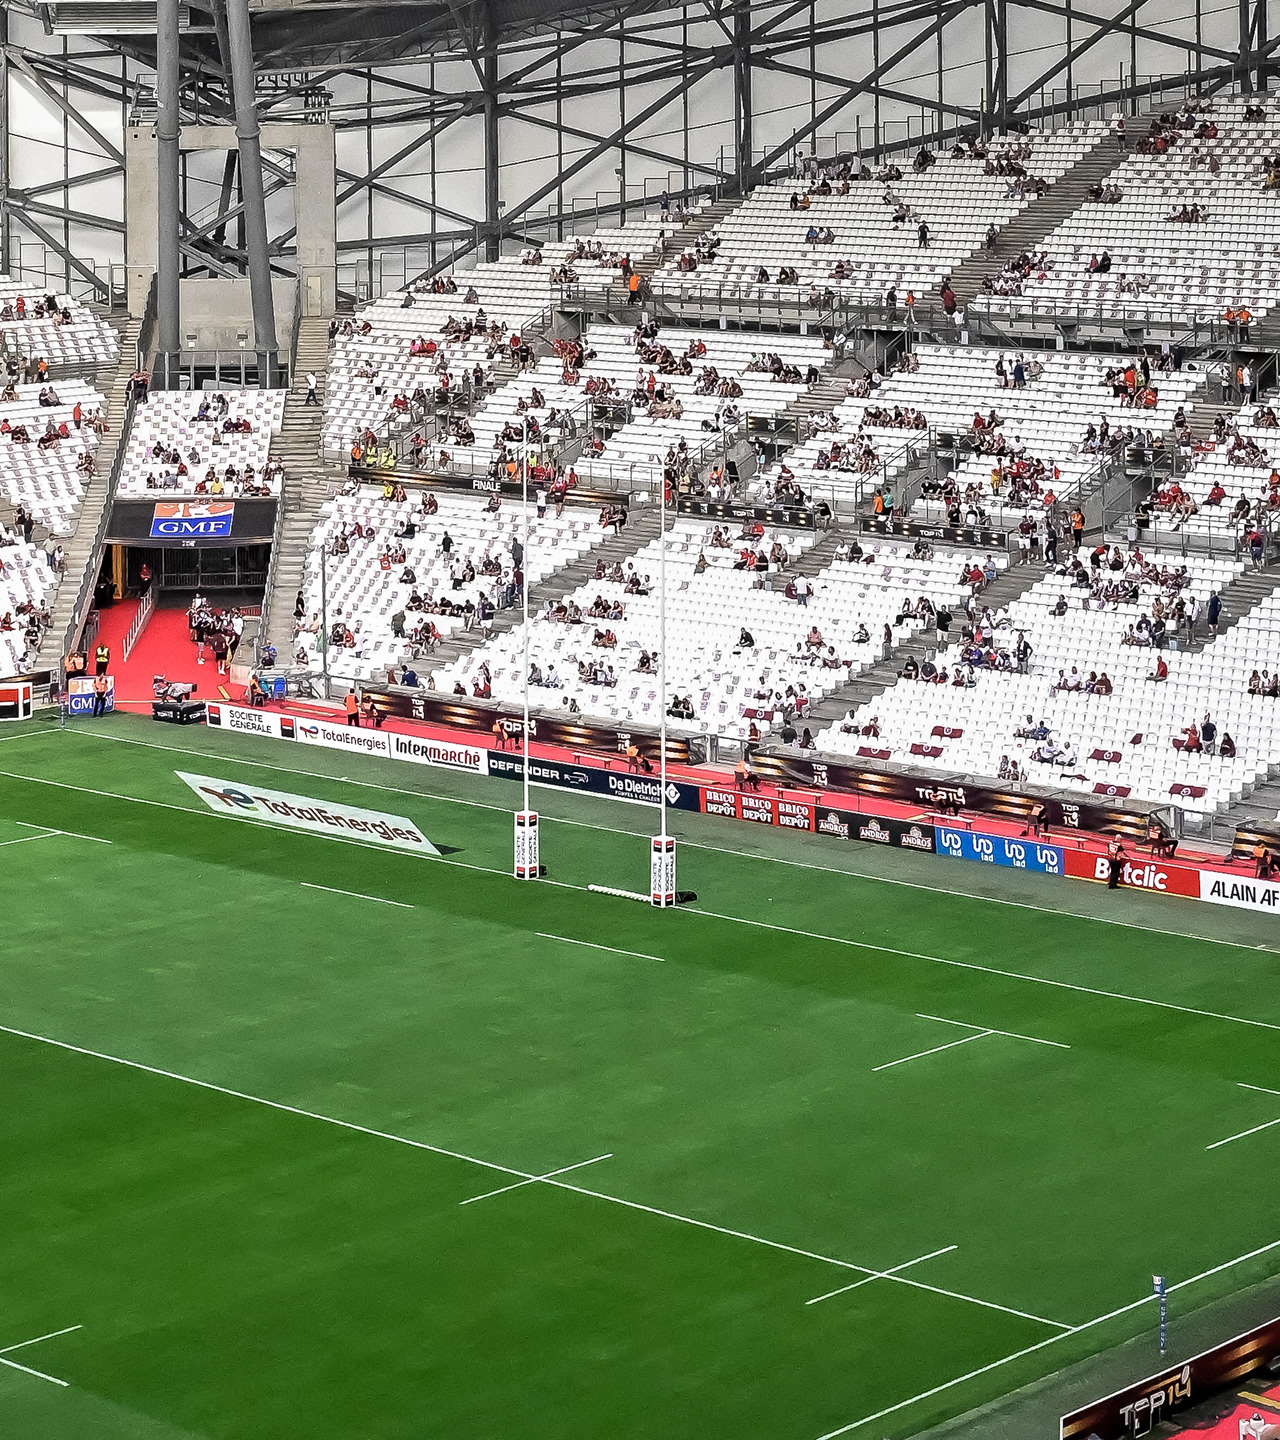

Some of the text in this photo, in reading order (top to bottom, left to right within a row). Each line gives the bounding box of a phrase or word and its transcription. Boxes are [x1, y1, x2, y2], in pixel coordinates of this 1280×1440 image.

[472, 480, 501, 491] FINALE
[158, 521, 226, 533] GMF
[229, 709, 264, 723] SOCIETE
[230, 719, 272, 734] GENERALE
[321, 728, 387, 751] TotalEnergies
[395, 737, 481, 767] Intermarché
[608, 775, 624, 790] De
[706, 790, 735, 804] BRICO
[741, 797, 772, 810] BRICO
[778, 802, 809, 816] BRICO
[252, 796, 422, 843] TotalEnergies
[819, 821, 848, 834] ANDROS
[860, 828, 890, 841] ANDROS
[901, 835, 932, 848] ANDROS
[1094, 857, 1168, 890] Btclic
[1210, 880, 1256, 903] ALAIN
